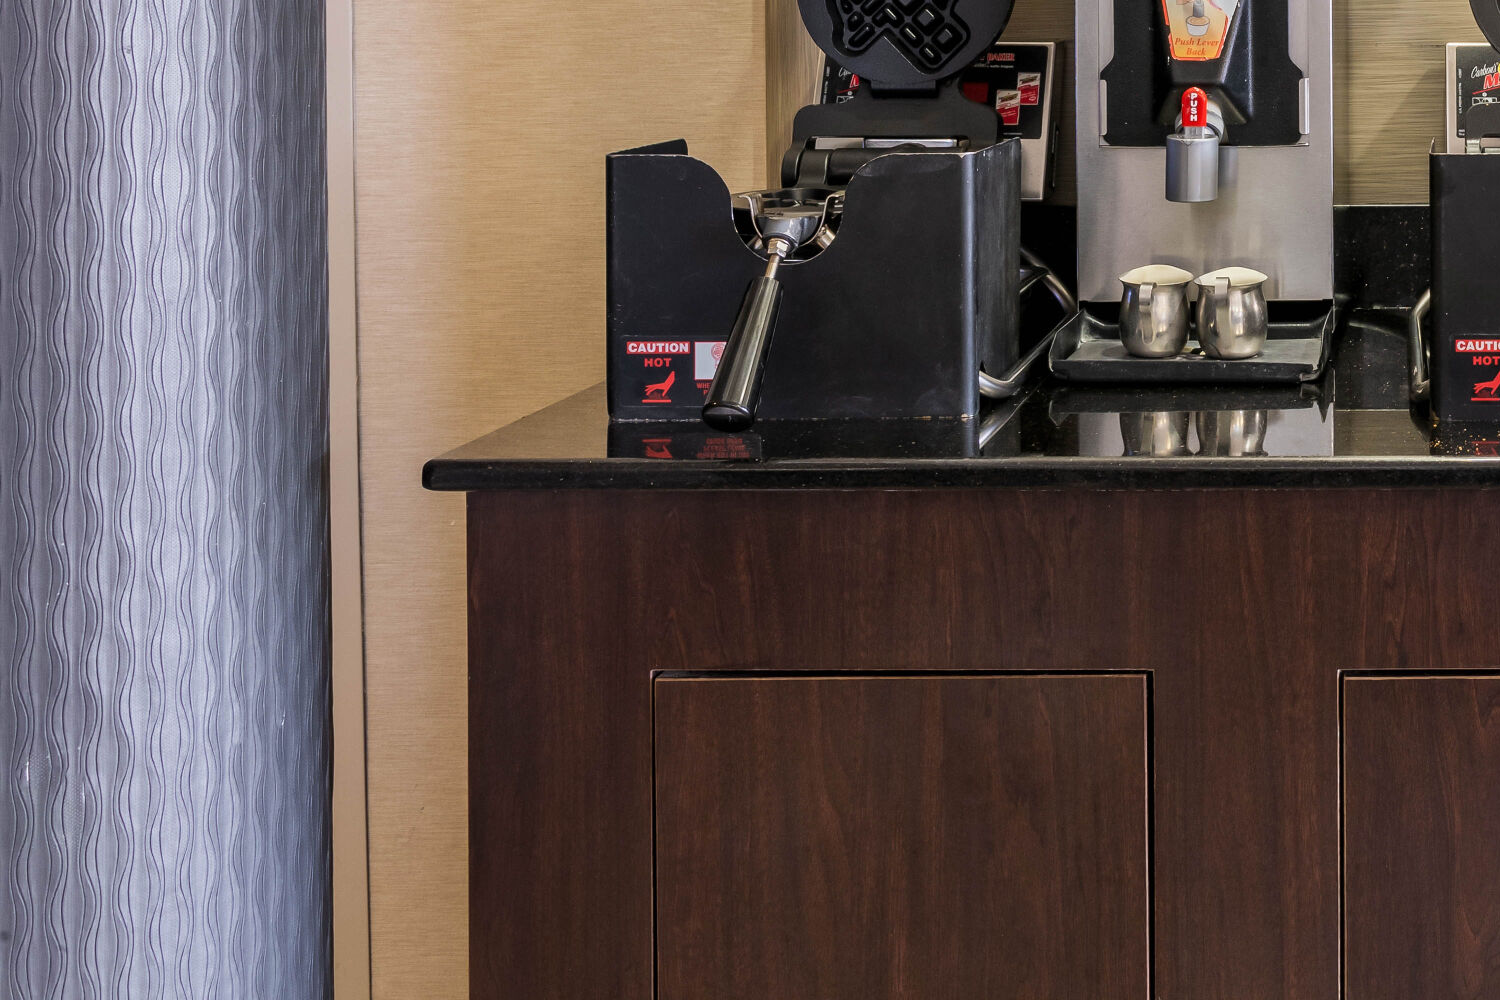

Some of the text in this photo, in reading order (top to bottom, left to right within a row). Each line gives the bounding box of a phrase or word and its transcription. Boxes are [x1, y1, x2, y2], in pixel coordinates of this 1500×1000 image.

[1174, 37, 1220, 46] Push Lever
[1186, 47, 1207, 56] Back
[628, 342, 689, 353] CAUTION
[644, 358, 672, 368] HOT
[1472, 356, 1500, 366] HOT
